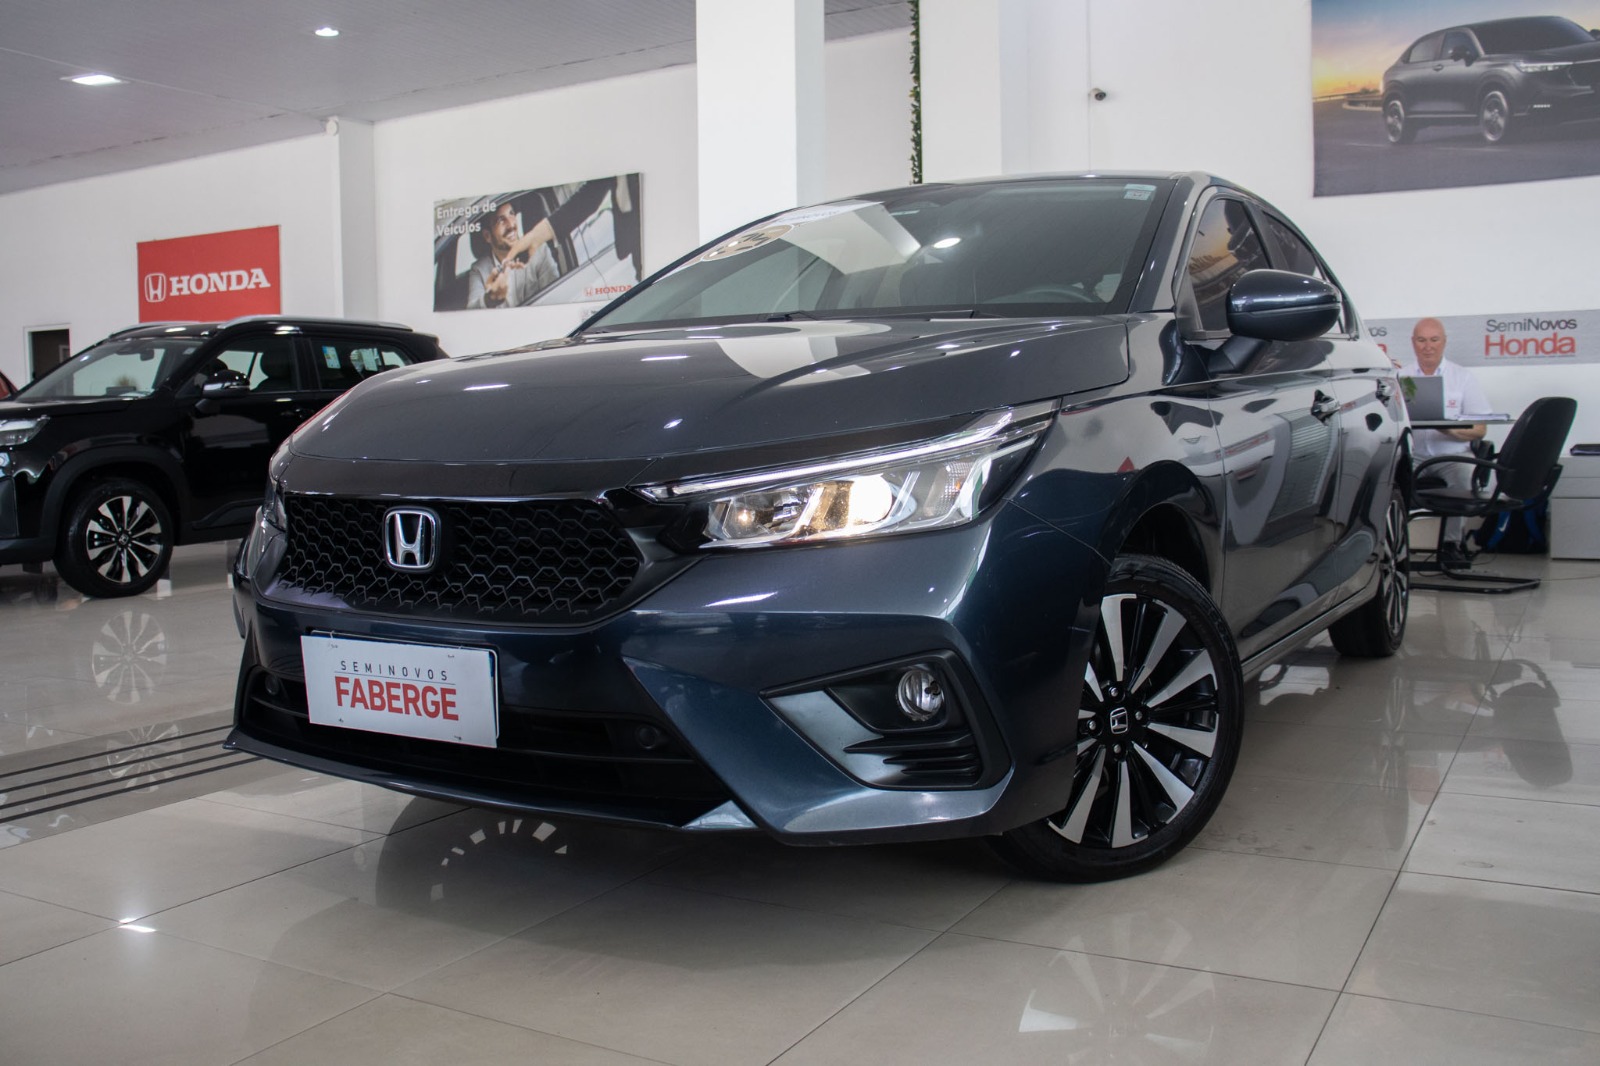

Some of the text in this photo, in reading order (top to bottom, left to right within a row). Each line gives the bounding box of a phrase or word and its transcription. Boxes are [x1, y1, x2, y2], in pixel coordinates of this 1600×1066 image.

[437, 200, 497, 218] Entrega de
[169, 267, 271, 296] HONDA
[1485, 318, 1578, 333] SemiNovos
[1484, 331, 1576, 356] Honda
[340, 660, 449, 681] SEMINOVOS
[334, 675, 460, 721] FABERGE
